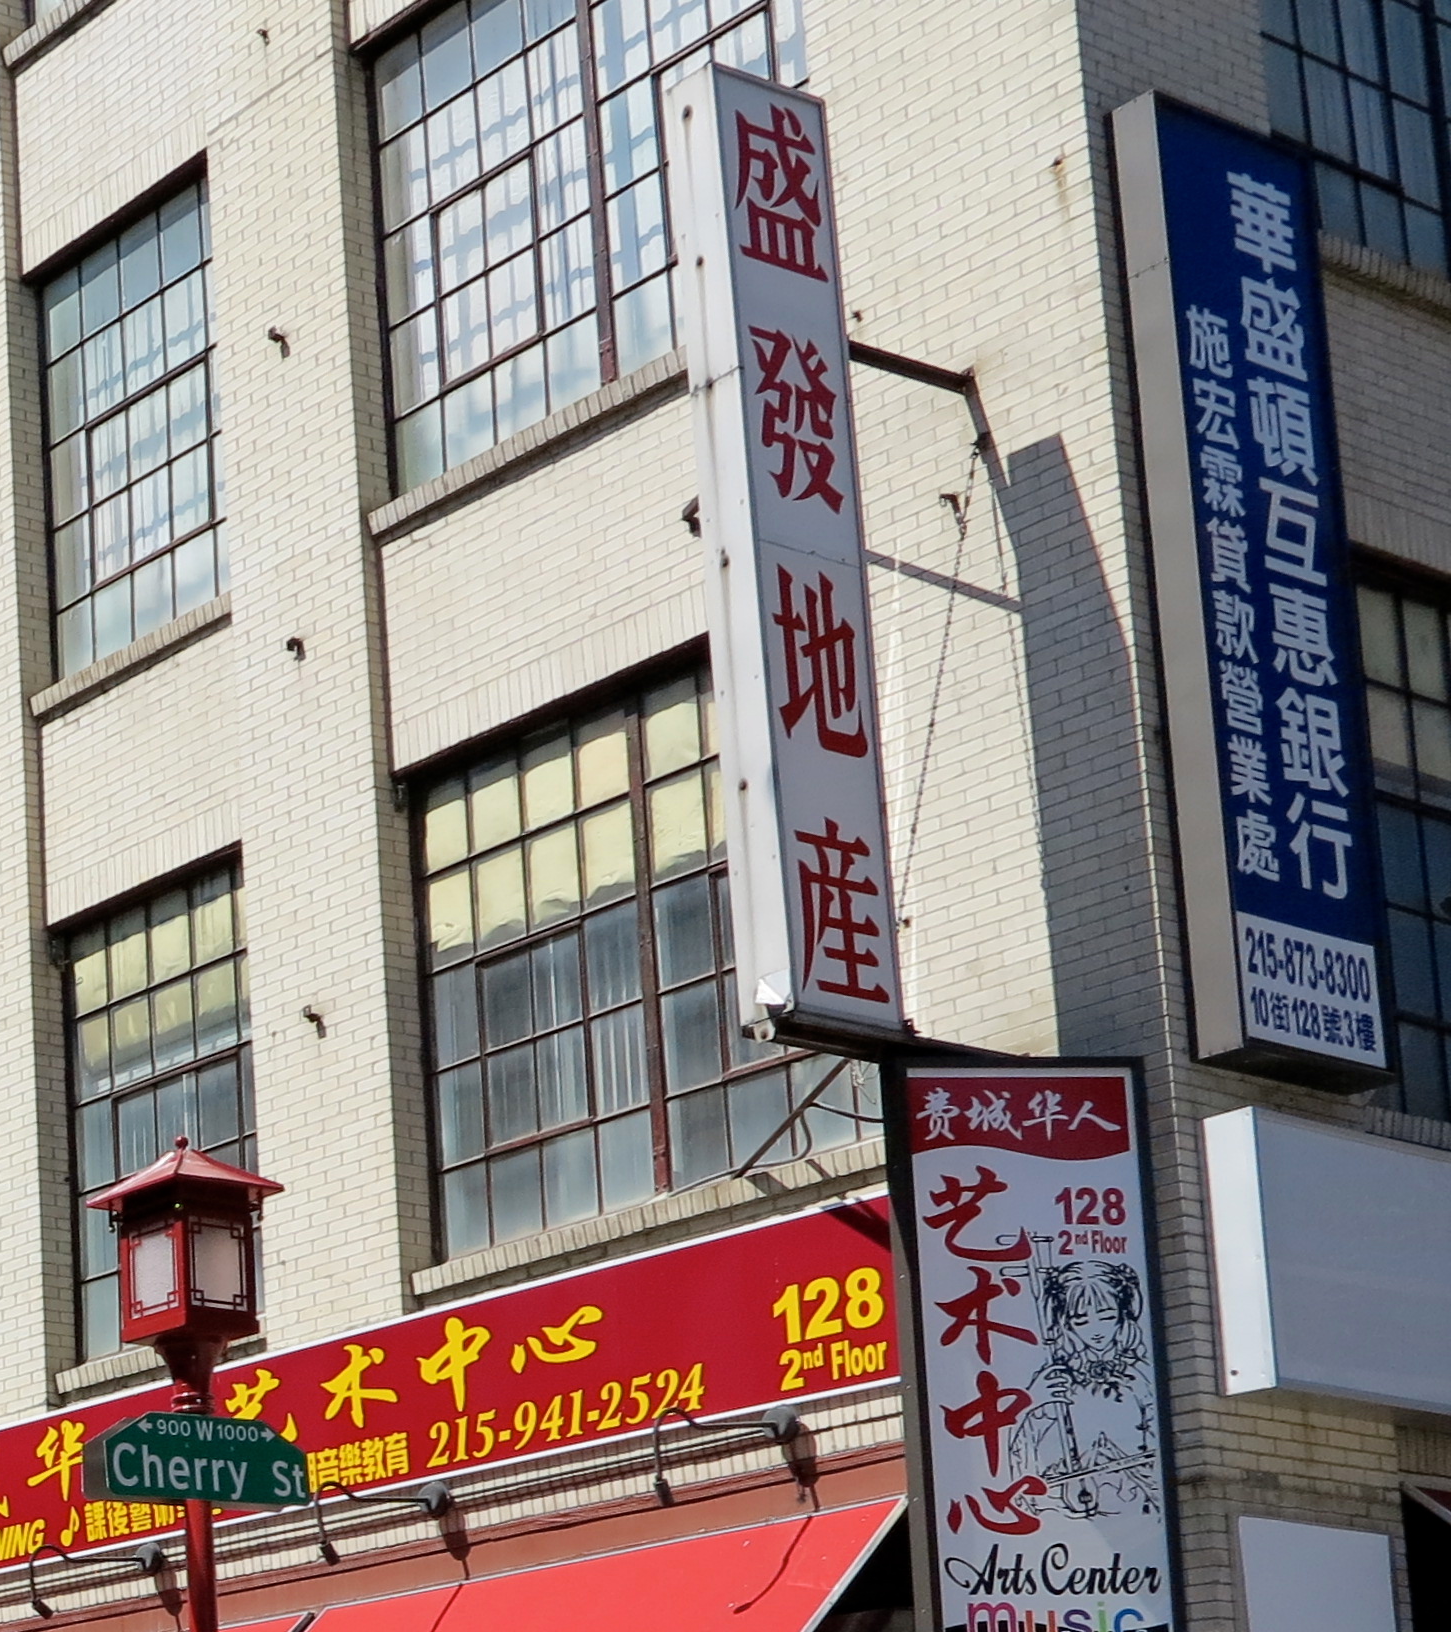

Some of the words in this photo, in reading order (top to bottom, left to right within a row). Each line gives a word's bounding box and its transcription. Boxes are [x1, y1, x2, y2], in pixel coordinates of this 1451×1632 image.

[1227, 171, 1353, 900] 華盛頓互惠銀行
[1185, 304, 1281, 883] 施宏霖貸款營業處
[1244, 925, 1371, 1002] 215-873-8300
[1054, 1187, 1127, 1226] 128
[1057, 1229, 1089, 1256] 2nd
[1091, 1231, 1128, 1255] Floor
[771, 1266, 886, 1345] 128
[778, 1344, 825, 1392] 2nd
[829, 1338, 888, 1383] Floor
[922, 1165, 1048, 1535] 艺术中心
[155, 1418, 191, 1438] 900
[195, 1419, 214, 1442] W
[216, 1423, 259, 1443] 1000
[427, 1361, 705, 1468] 215-941-2524
[112, 1441, 248, 1500] Cherry
[271, 1459, 307, 1498] St
[944, 1543, 1037, 1597] Arts
[1041, 1542, 1162, 1597] Center
